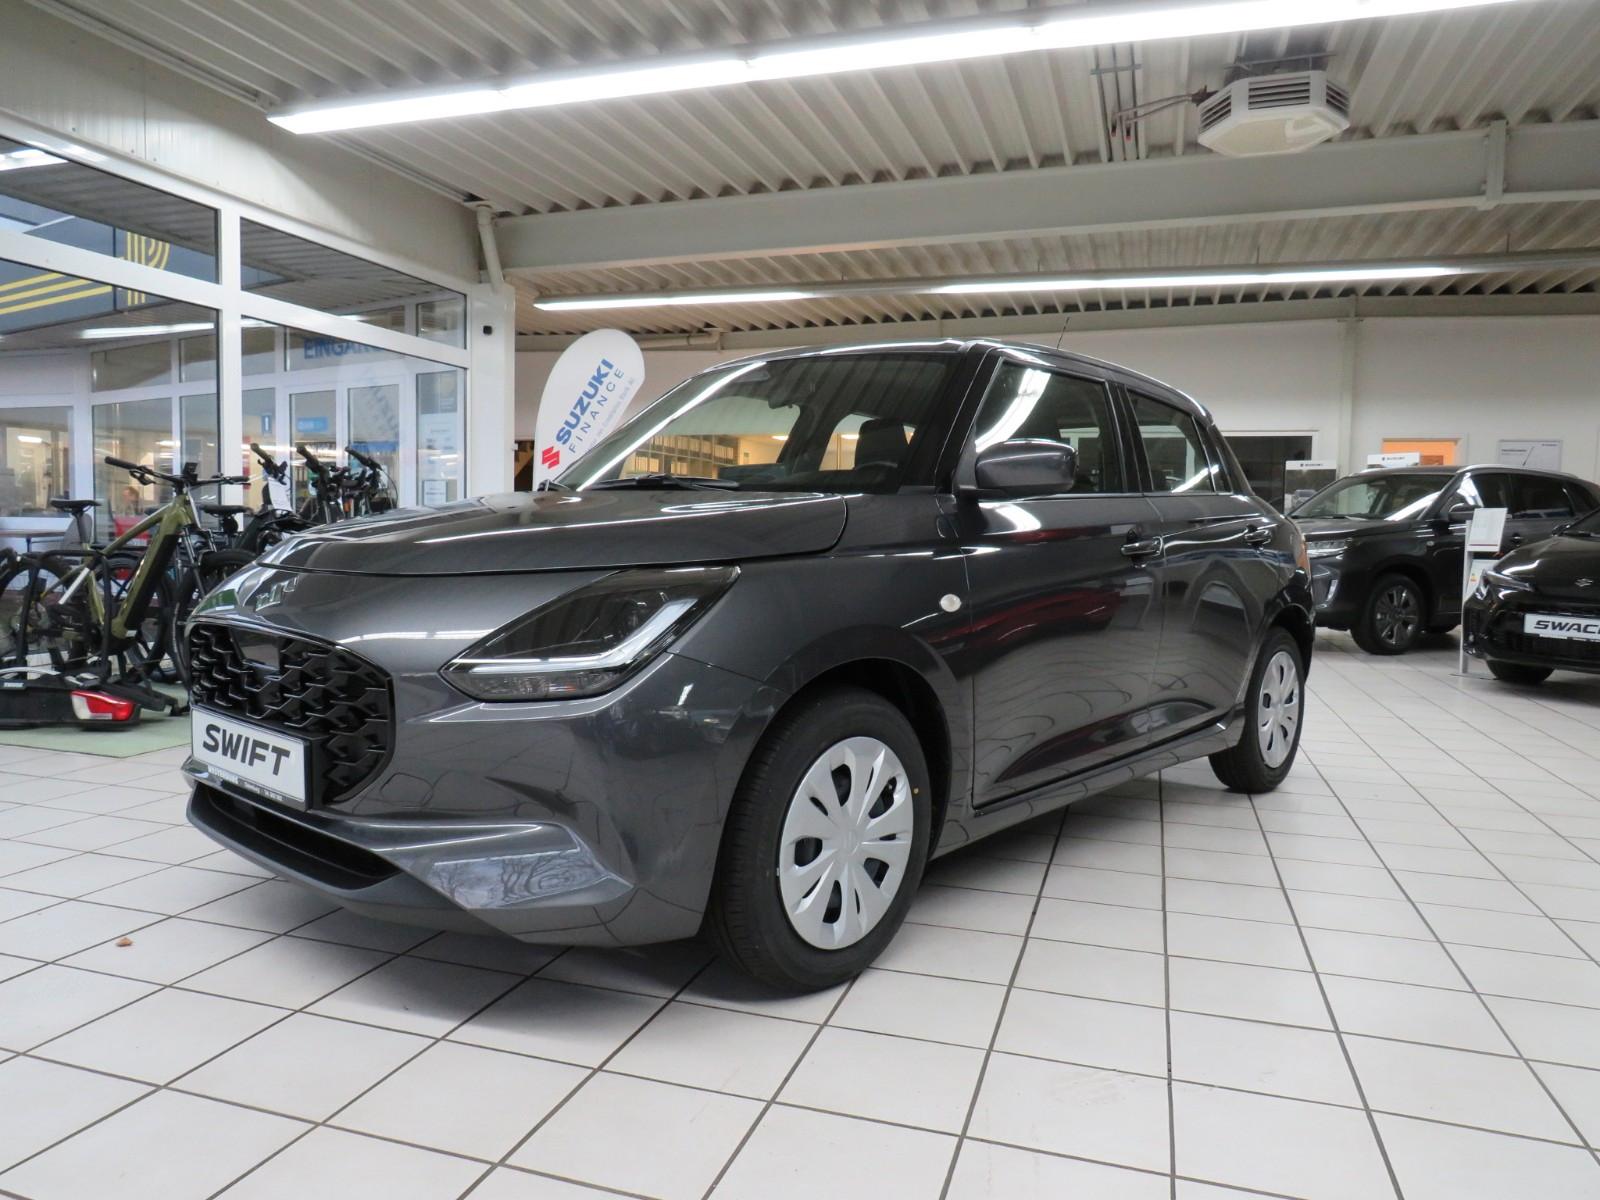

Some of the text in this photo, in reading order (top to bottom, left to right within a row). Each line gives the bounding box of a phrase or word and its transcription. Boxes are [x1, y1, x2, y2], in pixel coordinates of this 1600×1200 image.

[556, 358, 614, 445] SUZUKI
[569, 368, 625, 453] FINANCE
[1533, 620, 1600, 634] SWAC
[203, 723, 291, 776] SWIFT
